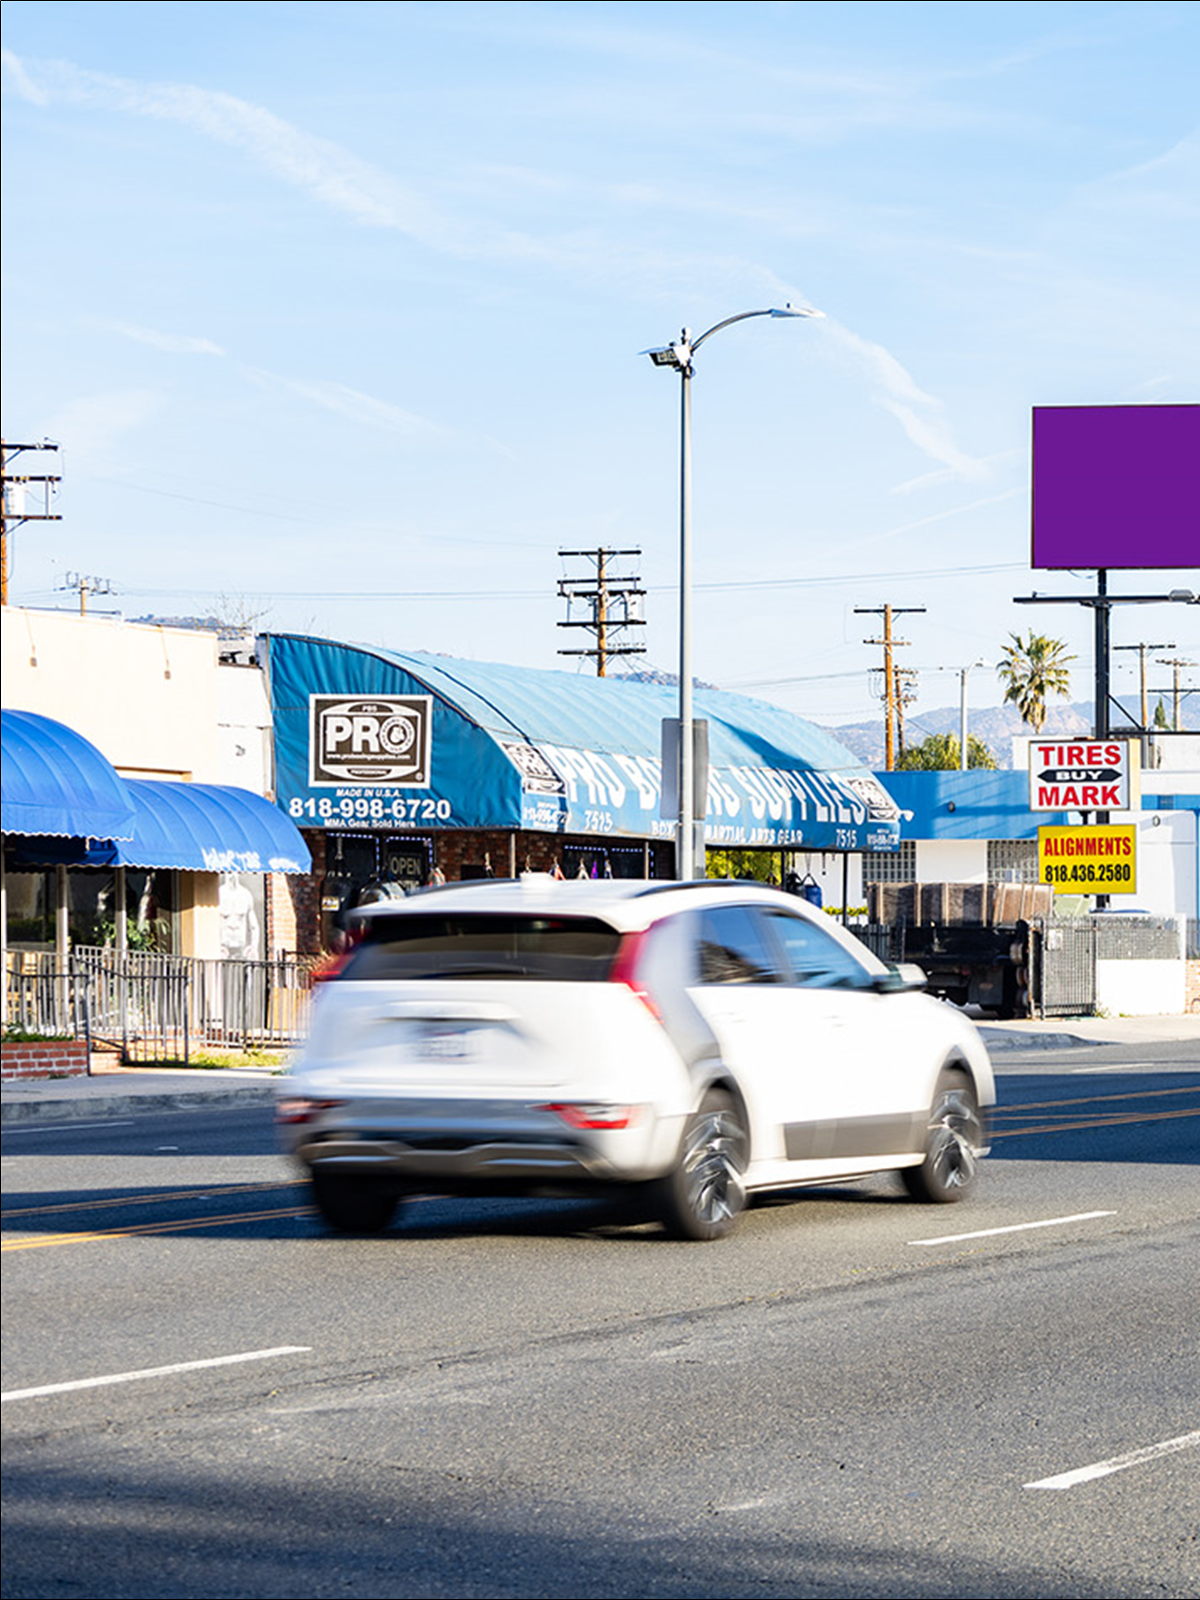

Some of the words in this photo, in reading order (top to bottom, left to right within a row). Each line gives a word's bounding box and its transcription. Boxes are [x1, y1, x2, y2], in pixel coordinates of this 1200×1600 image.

[325, 715, 416, 754] PRO
[1038, 745, 1122, 767] TIRES
[540, 743, 626, 809] PRO
[727, 764, 866, 826] SUPPLIES
[1055, 769, 1103, 782] BUY
[336, 788, 363, 798] MADE
[364, 788, 374, 798] IN
[1038, 785, 1121, 807] MARK
[289, 797, 452, 820] 818-998-6720
[324, 817, 347, 828] MMA
[349, 817, 370, 828] Gear
[371, 818, 392, 829] Sold
[394, 819, 416, 829] Here
[584, 809, 613, 833] 7515
[777, 828, 803, 845] GEAR
[836, 828, 858, 848] 7515
[1043, 836, 1132, 858] ALIGNMENTS
[390, 855, 421, 876] OPEN
[1045, 863, 1131, 883] 818.436.2580
